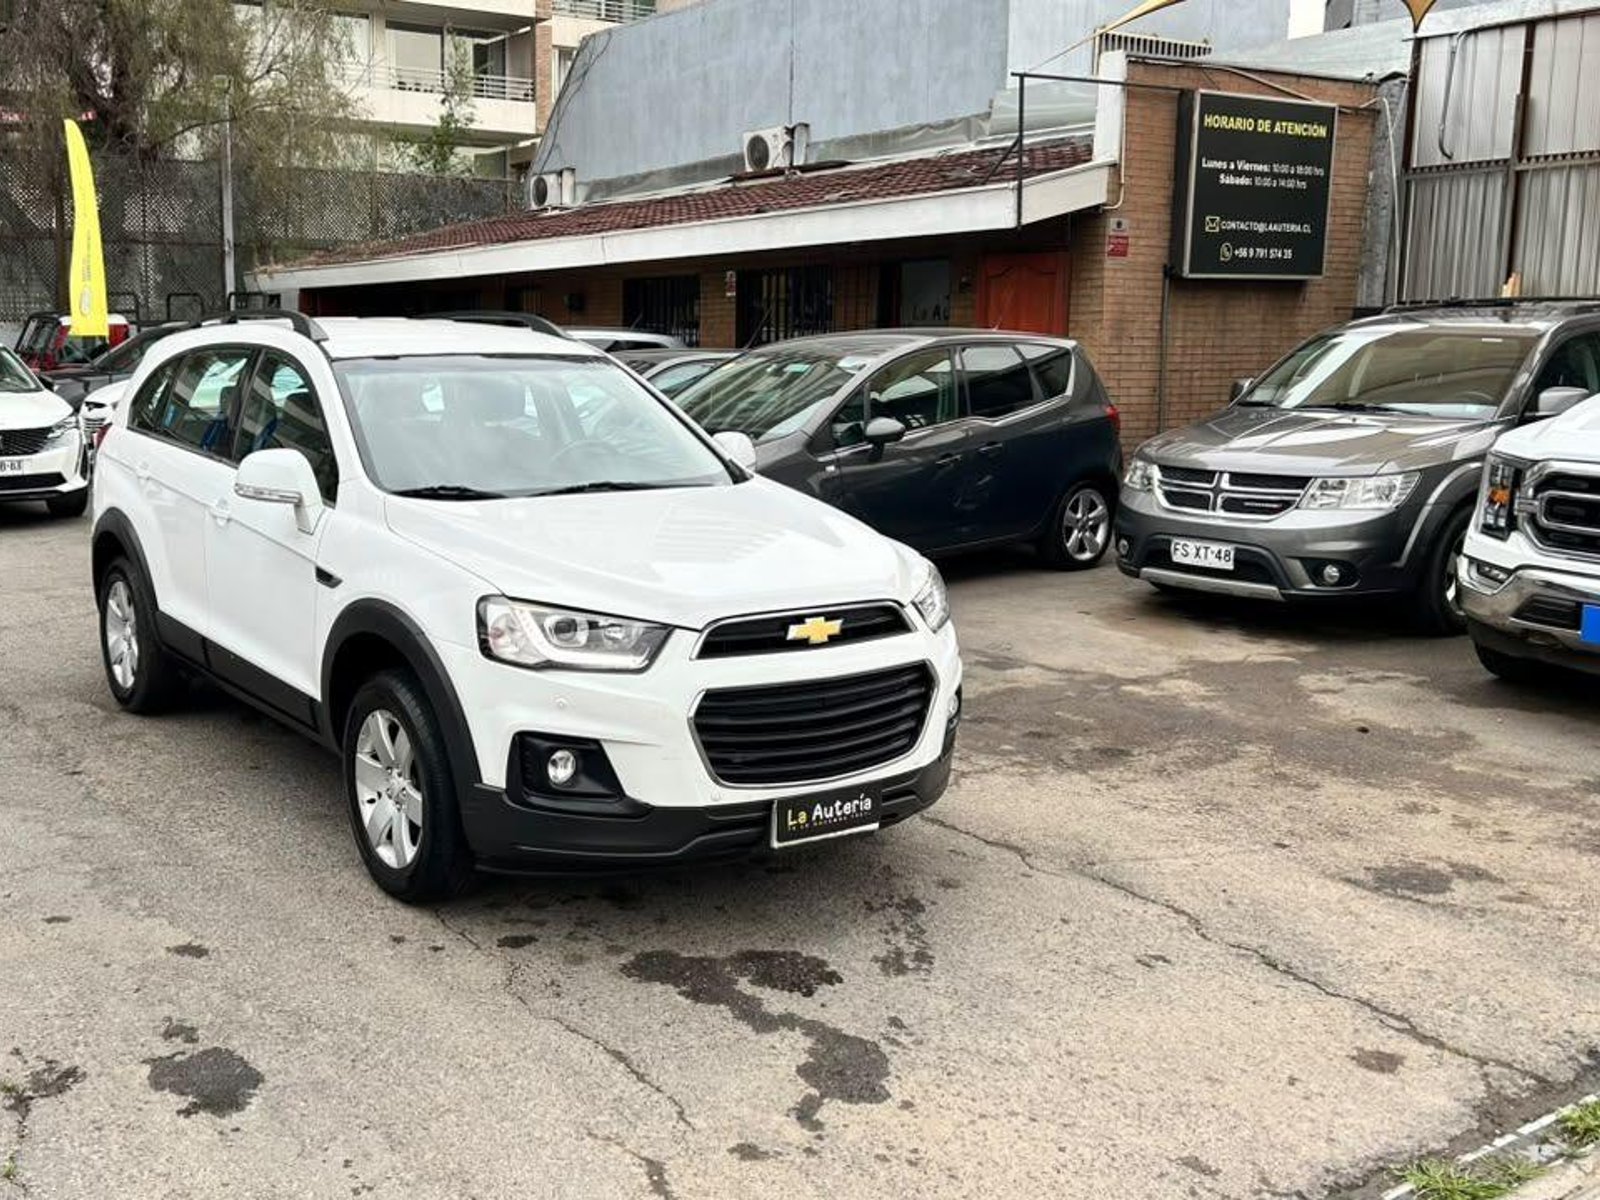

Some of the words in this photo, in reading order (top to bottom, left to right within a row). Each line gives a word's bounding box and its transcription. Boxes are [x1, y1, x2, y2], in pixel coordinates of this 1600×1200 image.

[1204, 114, 1255, 131] HORARIO
[1257, 119, 1271, 133] DE
[1201, 157, 1228, 170] Lunes
[1229, 161, 1235, 170] a
[1237, 160, 1271, 173] Viernes:
[1219, 173, 1253, 186] Sábado:
[1234, 247, 1248, 258] +56
[1248, 247, 1254, 258] 9
[1255, 247, 1268, 259] 791
[787, 809, 807, 826] La
[812, 793, 872, 821] Autería
